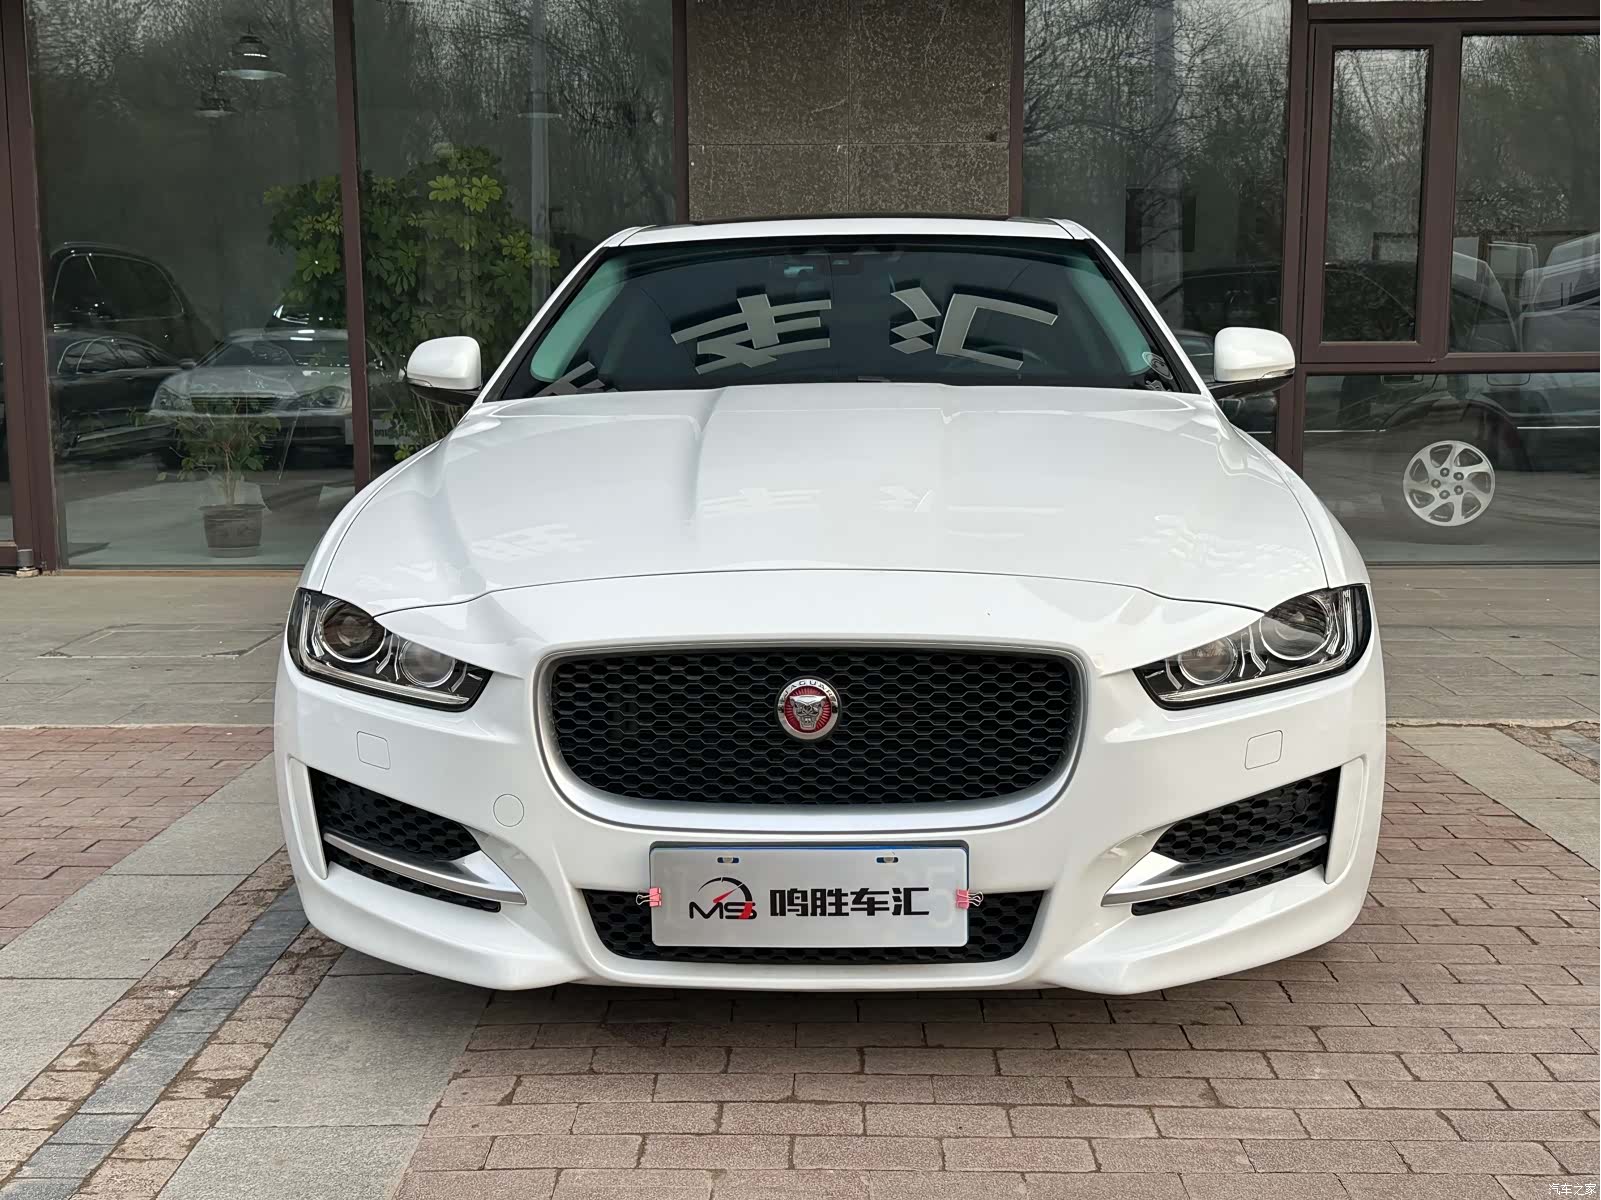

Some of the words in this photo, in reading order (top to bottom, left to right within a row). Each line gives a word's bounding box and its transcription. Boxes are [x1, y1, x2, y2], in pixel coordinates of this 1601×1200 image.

[784, 680, 833, 697] JAGUAR
[770, 887, 930, 917] 鸣胜车汇
